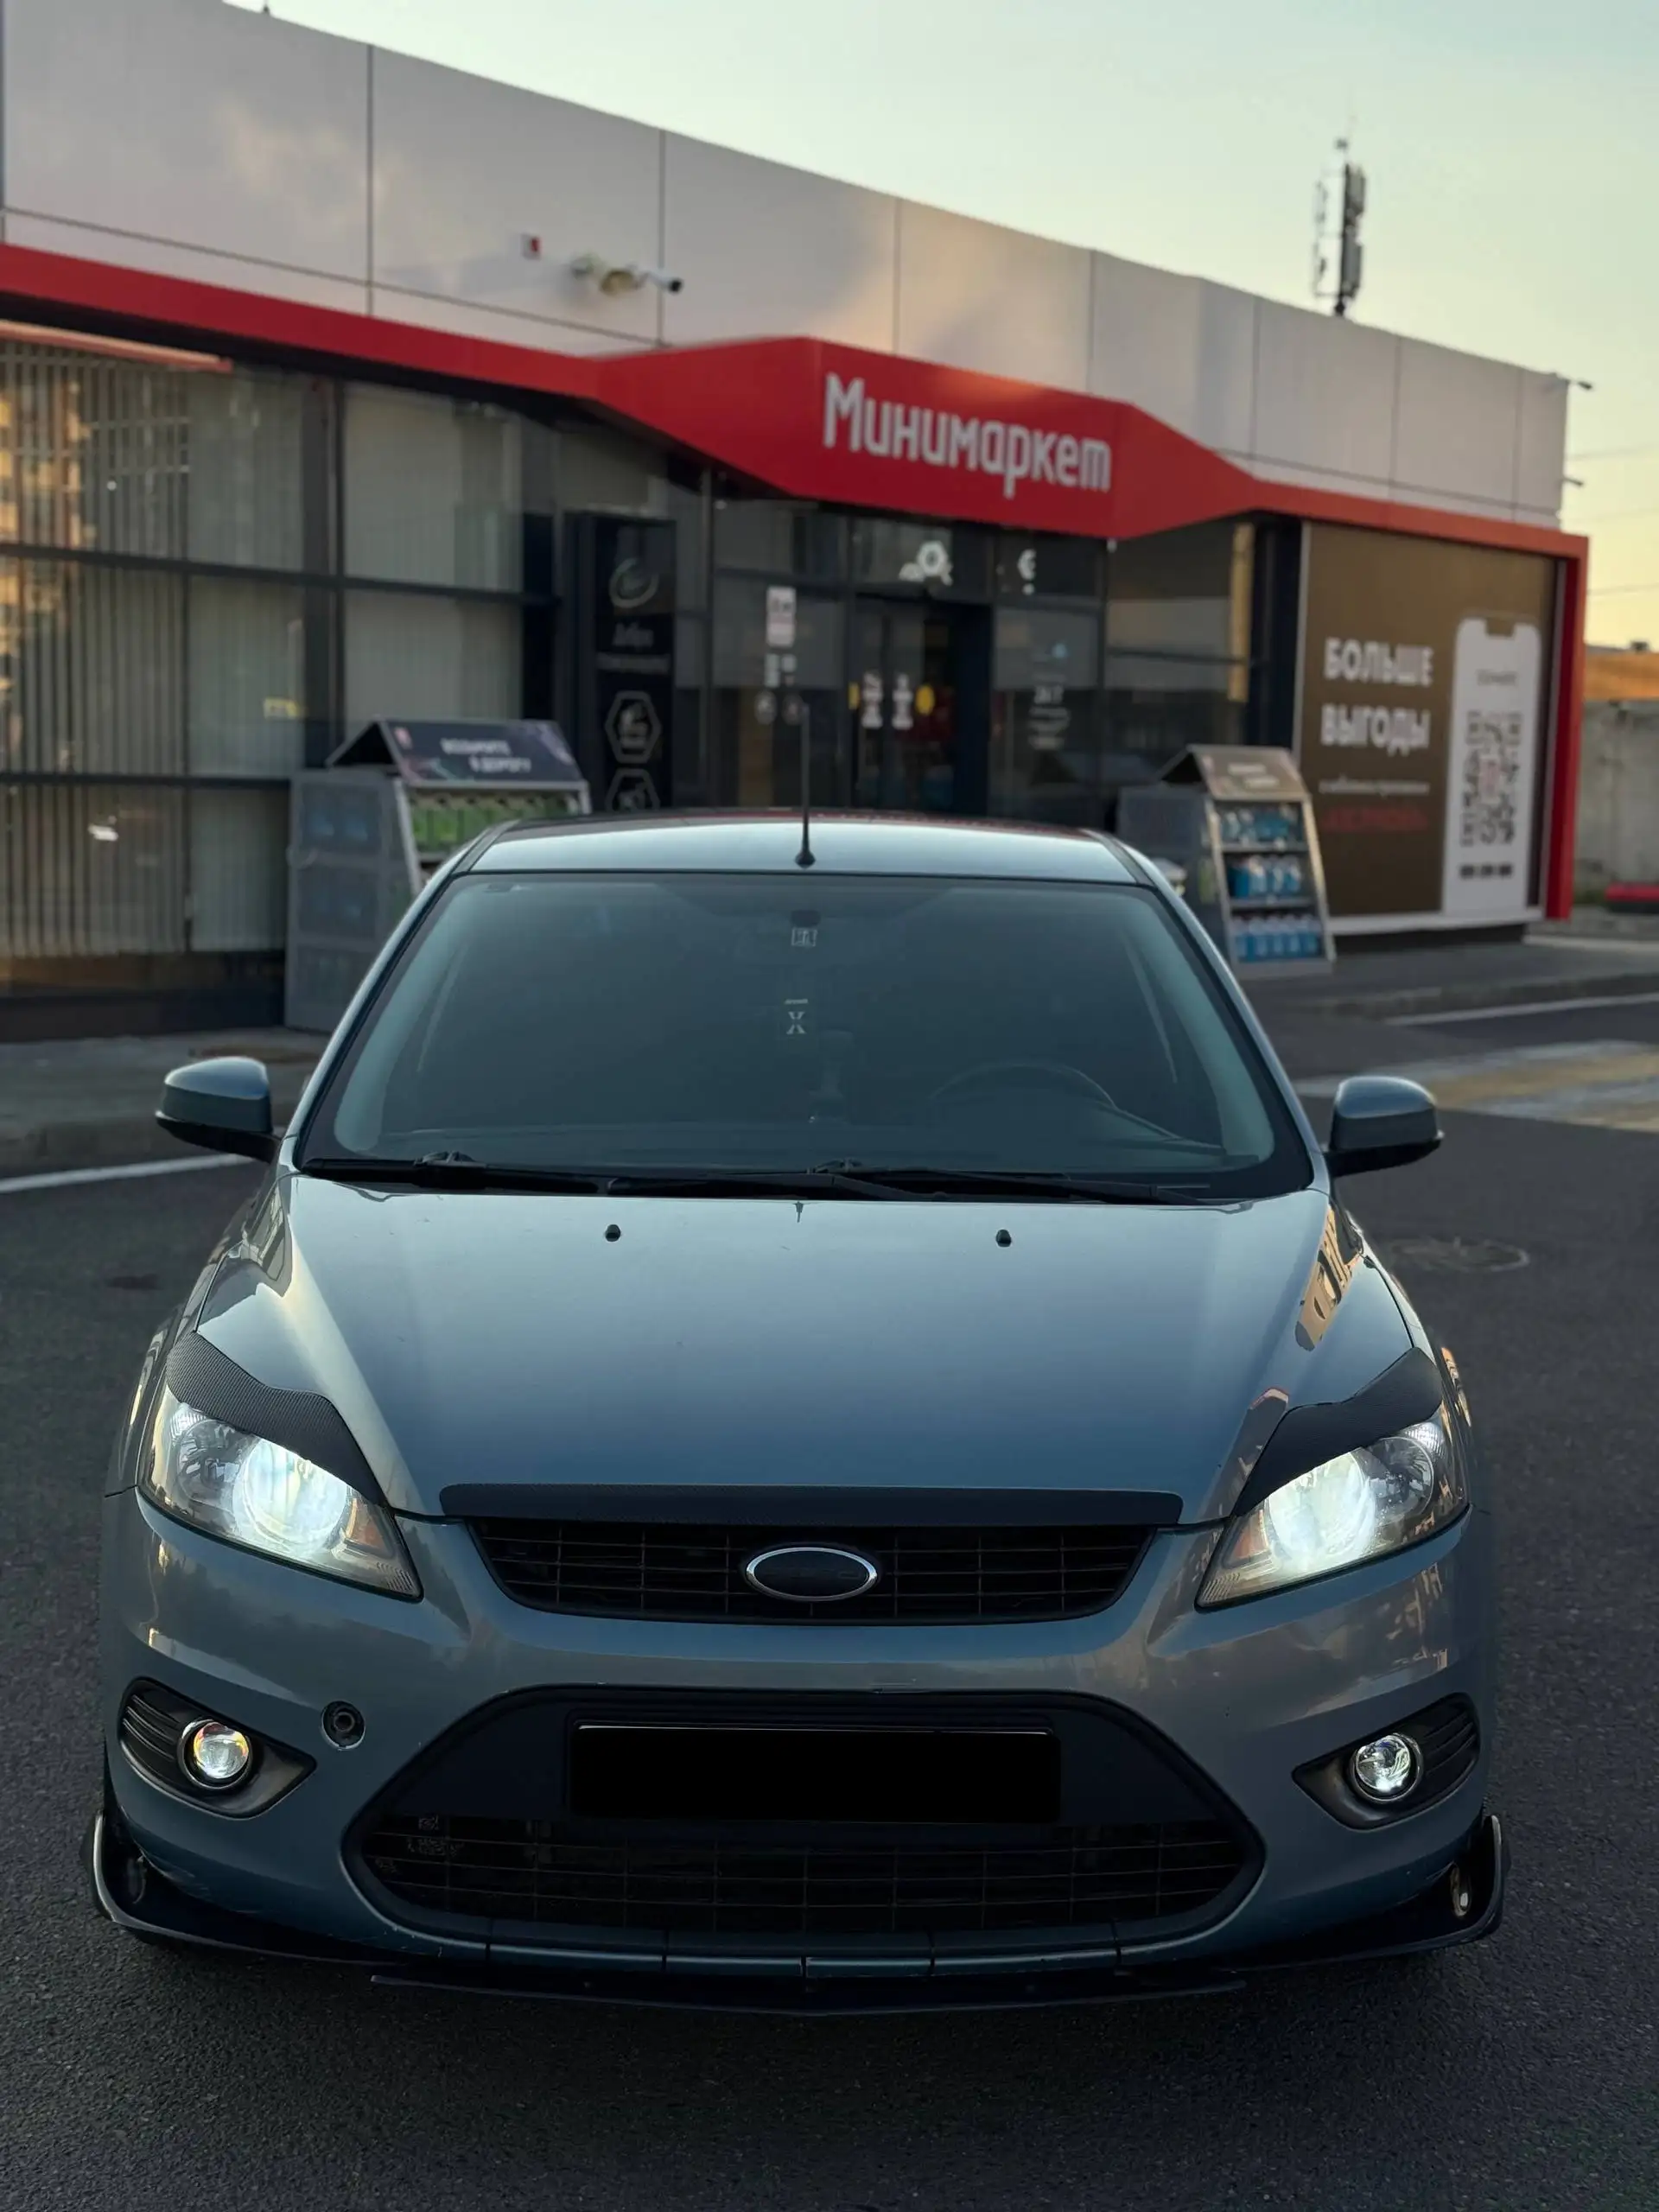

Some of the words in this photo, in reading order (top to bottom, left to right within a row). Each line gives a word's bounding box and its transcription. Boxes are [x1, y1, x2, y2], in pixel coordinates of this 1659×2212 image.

[823, 372, 1112, 499] Минимаркет
[1323, 636, 1434, 688] БОЛЬШЕ
[1319, 702, 1432, 757] ВЫГОДЫ
